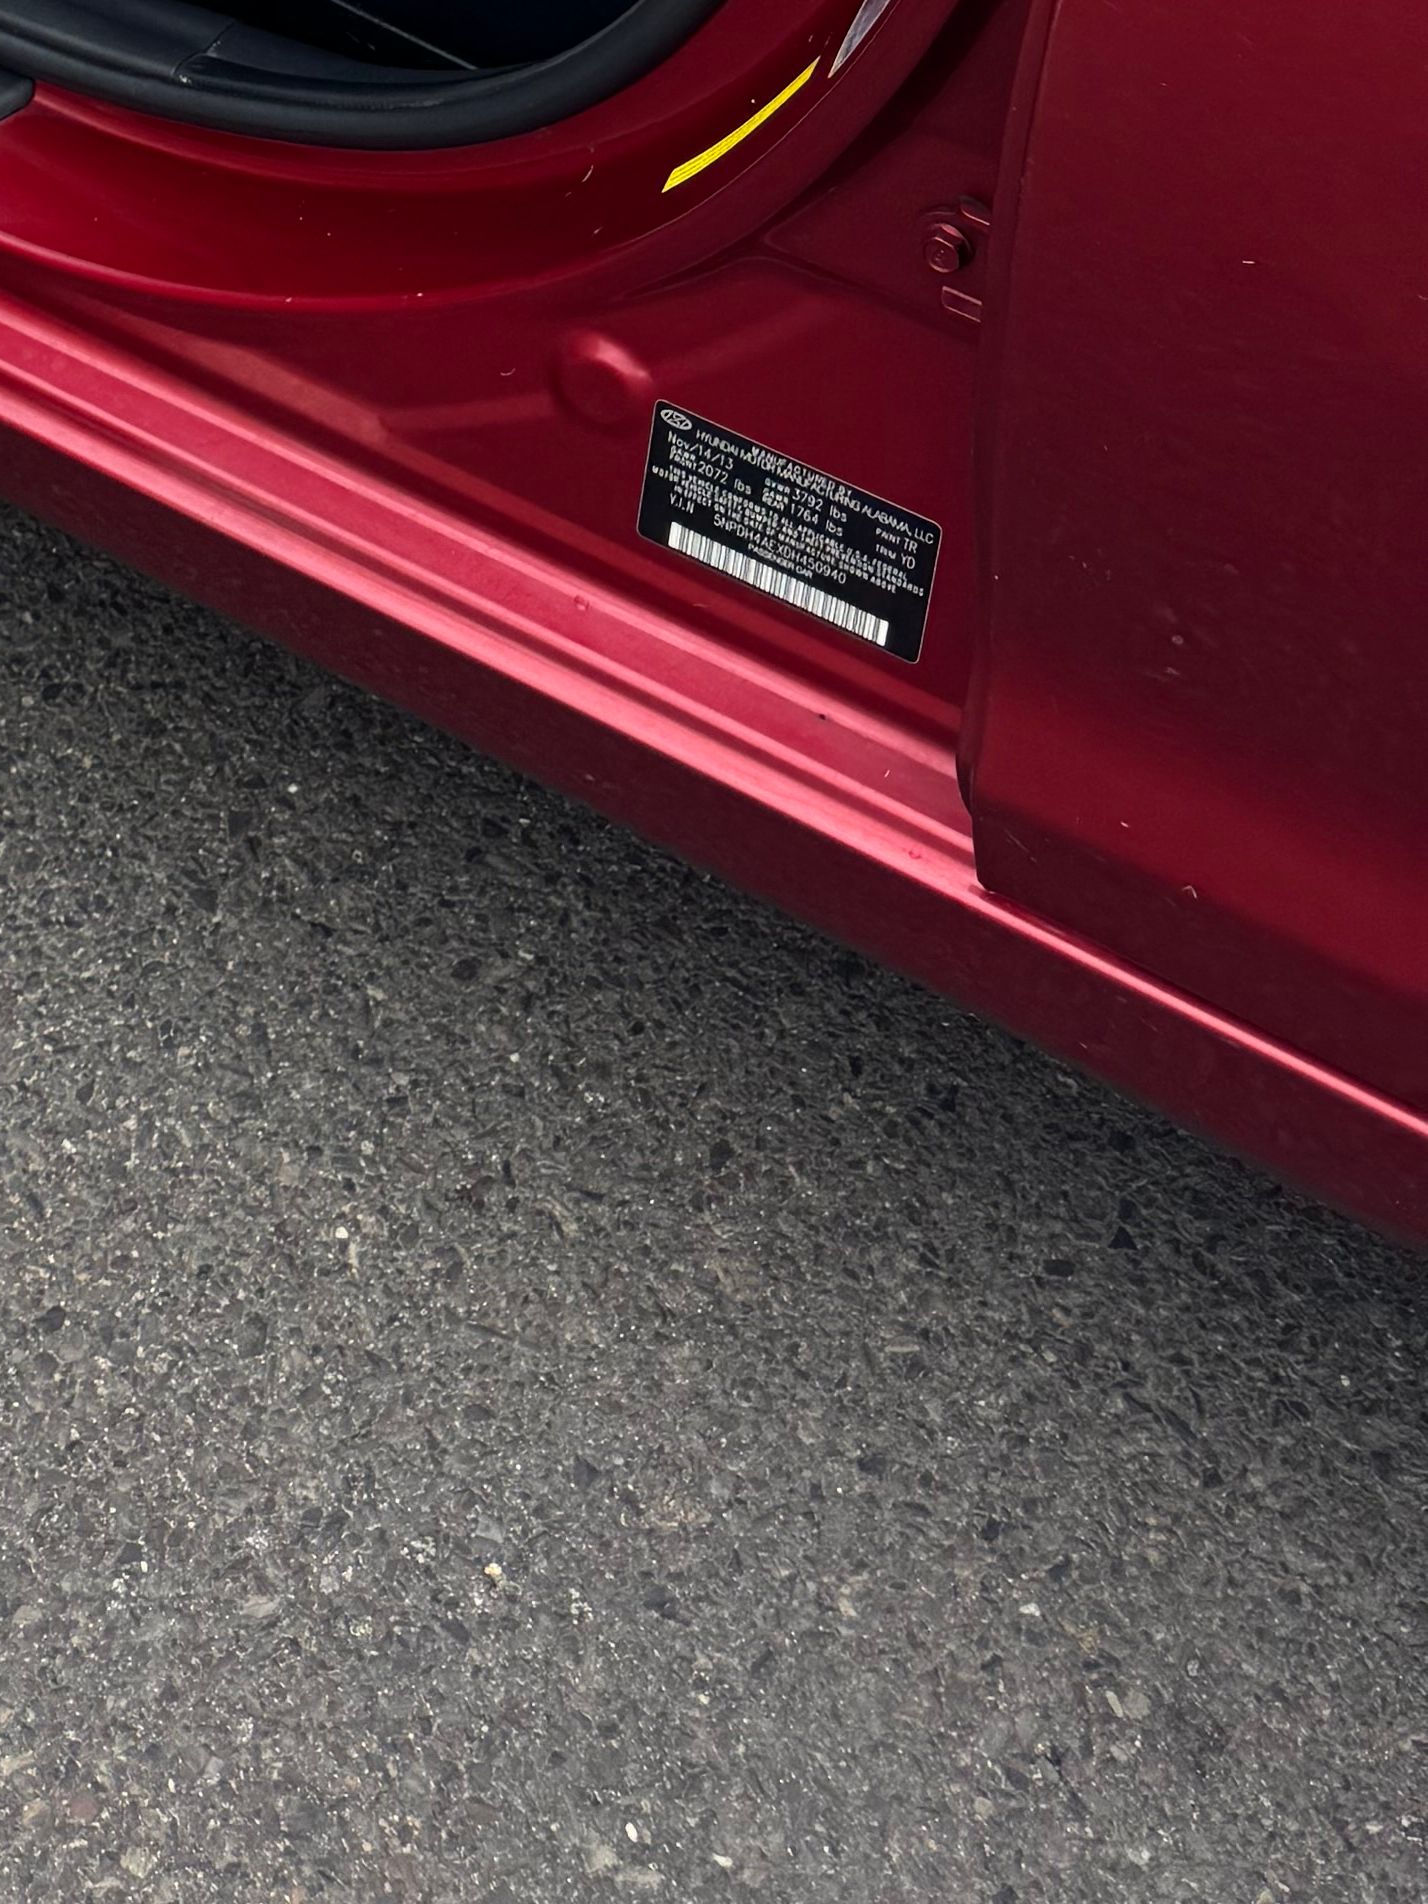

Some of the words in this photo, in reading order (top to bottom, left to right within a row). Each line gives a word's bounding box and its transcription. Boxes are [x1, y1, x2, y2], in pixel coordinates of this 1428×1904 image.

[667, 429, 734, 471] Nov/14/13
[697, 460, 728, 485] 2072
[733, 477, 752, 496] lbs
[789, 502, 819, 527] 1764
[825, 519, 844, 537] lbs
[792, 487, 823, 512] 3792
[829, 505, 848, 523] lbs
[902, 536, 918, 554] TR
[914, 526, 934, 545] LLC
